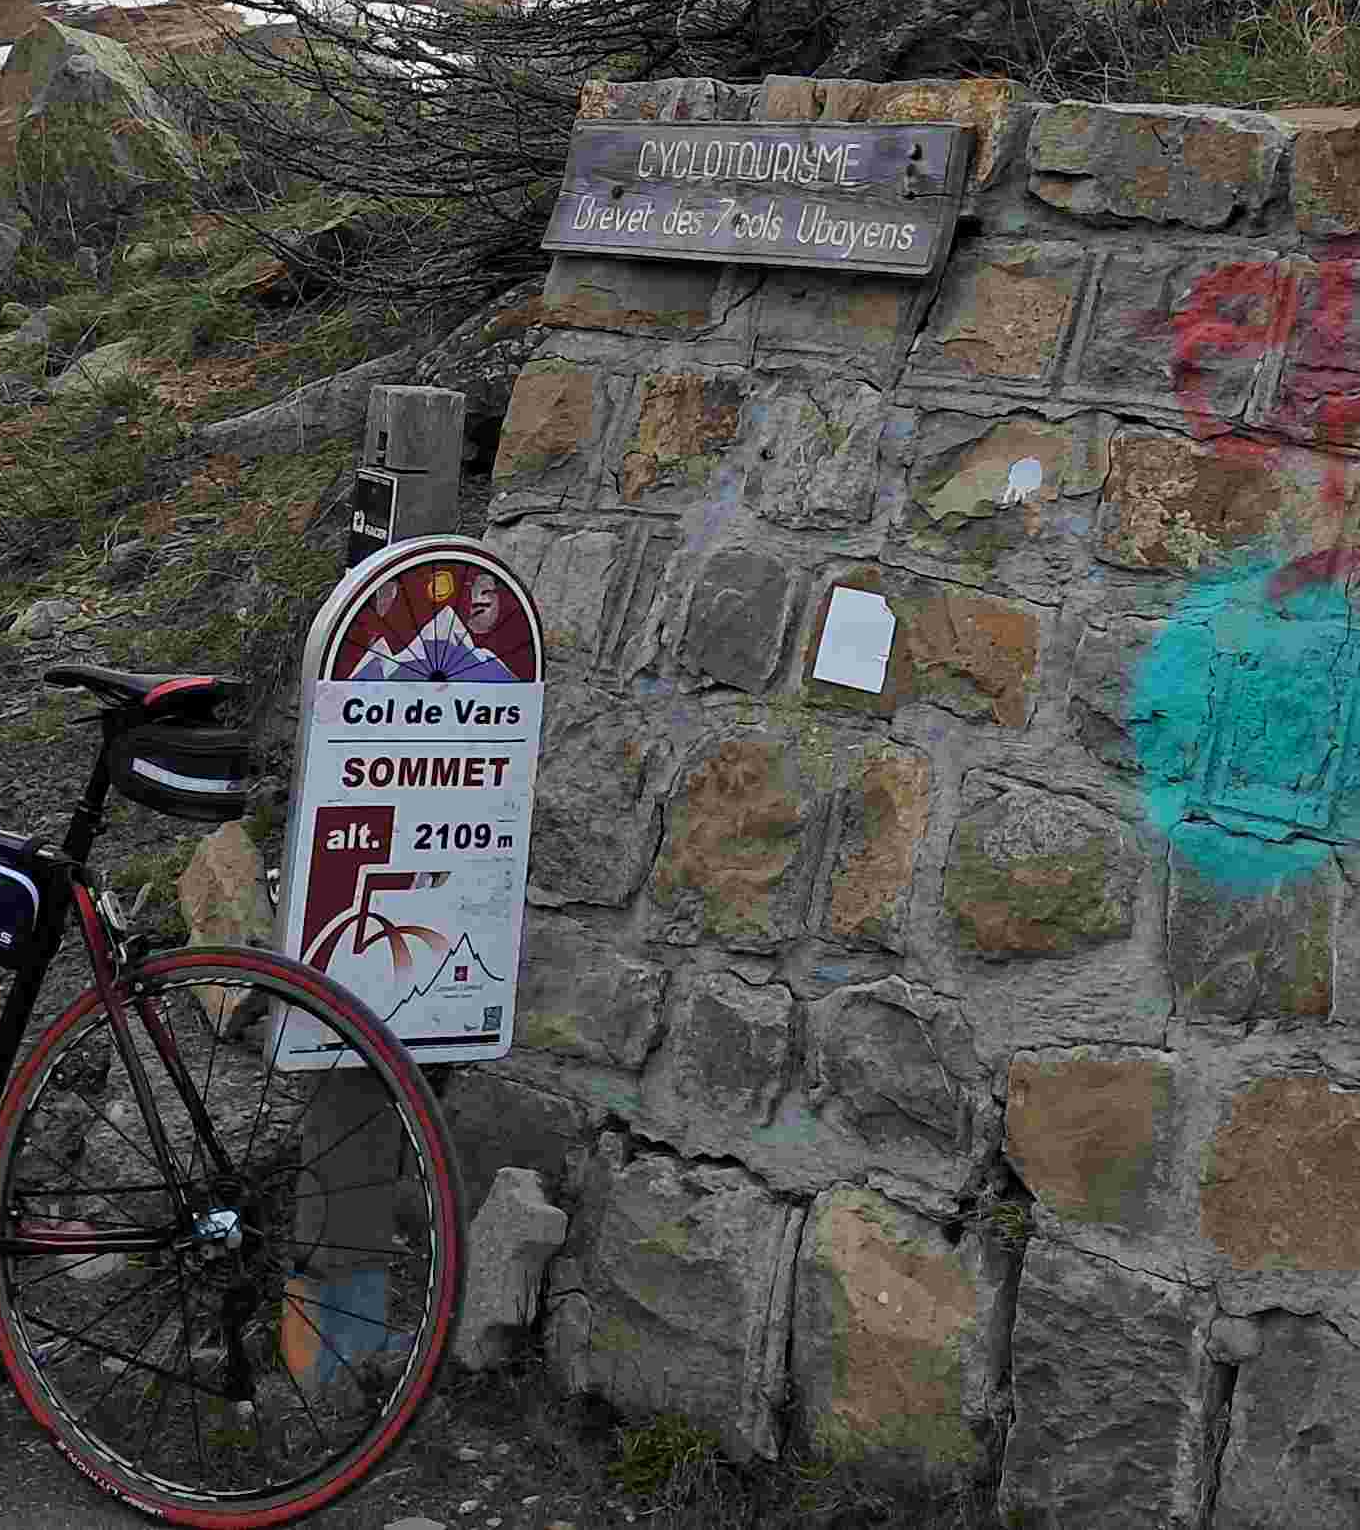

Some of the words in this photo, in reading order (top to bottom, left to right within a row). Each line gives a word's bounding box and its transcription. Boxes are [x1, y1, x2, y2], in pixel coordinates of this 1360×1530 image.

[638, 140, 862, 186] CYCLOTOURISME
[572, 195, 655, 233] Brevet
[663, 199, 703, 236] des
[709, 199, 737, 237] 7
[796, 204, 916, 260] Ubayens
[342, 698, 395, 725] Col
[404, 698, 443, 725] de
[454, 698, 521, 725] Vars
[342, 756, 510, 788] SOMMET
[326, 823, 380, 850] alt.
[413, 823, 491, 851] 2109
